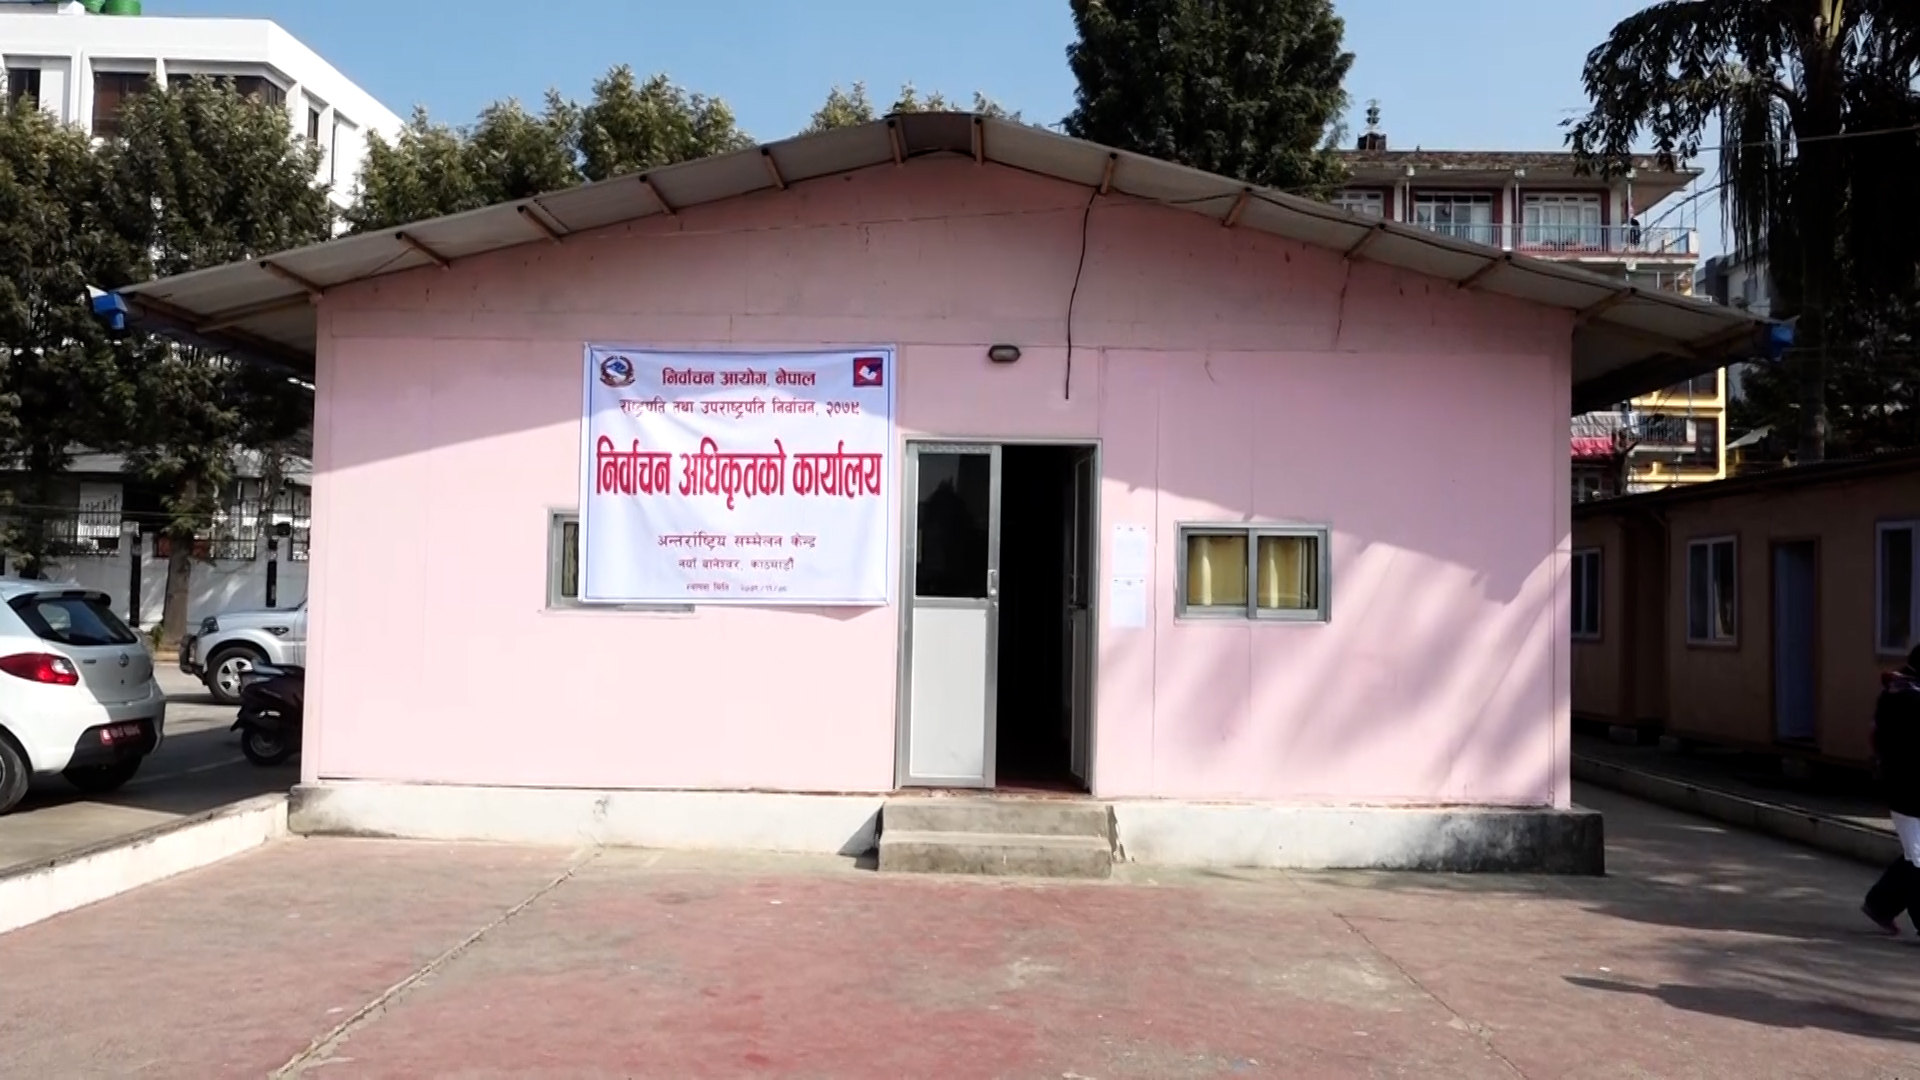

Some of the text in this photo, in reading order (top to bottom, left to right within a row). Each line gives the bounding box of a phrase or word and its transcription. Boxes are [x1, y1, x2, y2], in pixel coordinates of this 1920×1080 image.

[662, 367, 715, 385] निर्वाचन
[775, 368, 816, 386] नेपाल
[619, 395, 667, 417] राष्ट्रपति
[673, 400, 695, 413] तथा
[700, 396, 766, 419] उपराष्ट्रपति
[826, 401, 860, 417] २०७९
[596, 435, 882, 510] निर्वाचन अधिकृतको कार्यालय
[734, 532, 783, 548] सम्मेलन
[790, 532, 817, 549] केन्द्र
